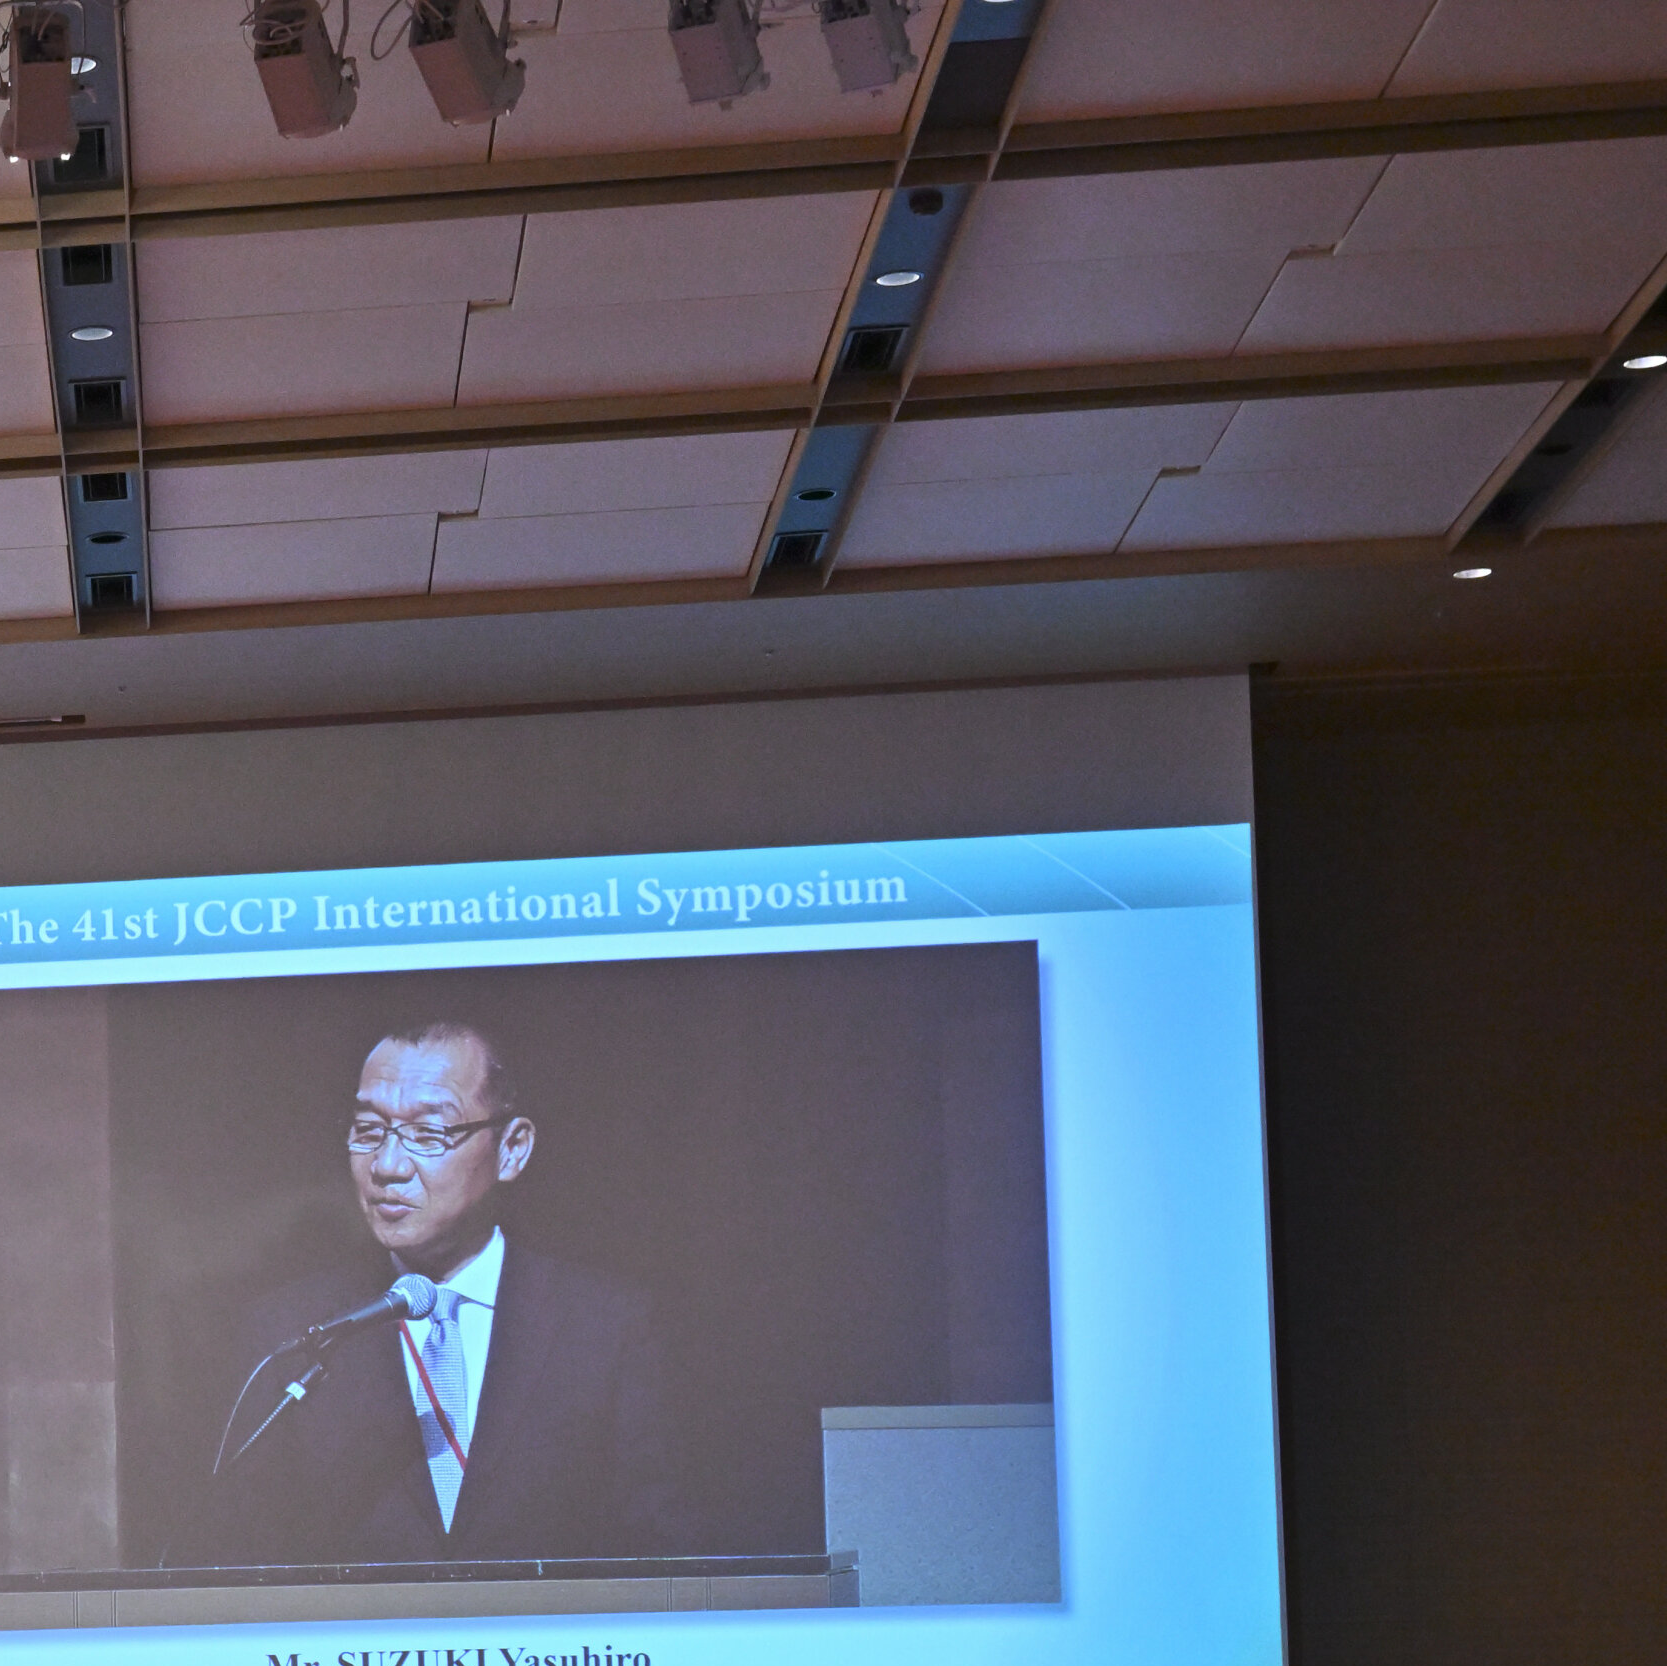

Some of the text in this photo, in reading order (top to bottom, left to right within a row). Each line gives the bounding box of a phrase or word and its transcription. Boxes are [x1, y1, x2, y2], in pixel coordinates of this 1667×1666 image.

[72, 907, 159, 941] 41st
[173, 898, 297, 944] JCCP
[313, 878, 620, 931] International
[638, 870, 907, 923] Symposium
